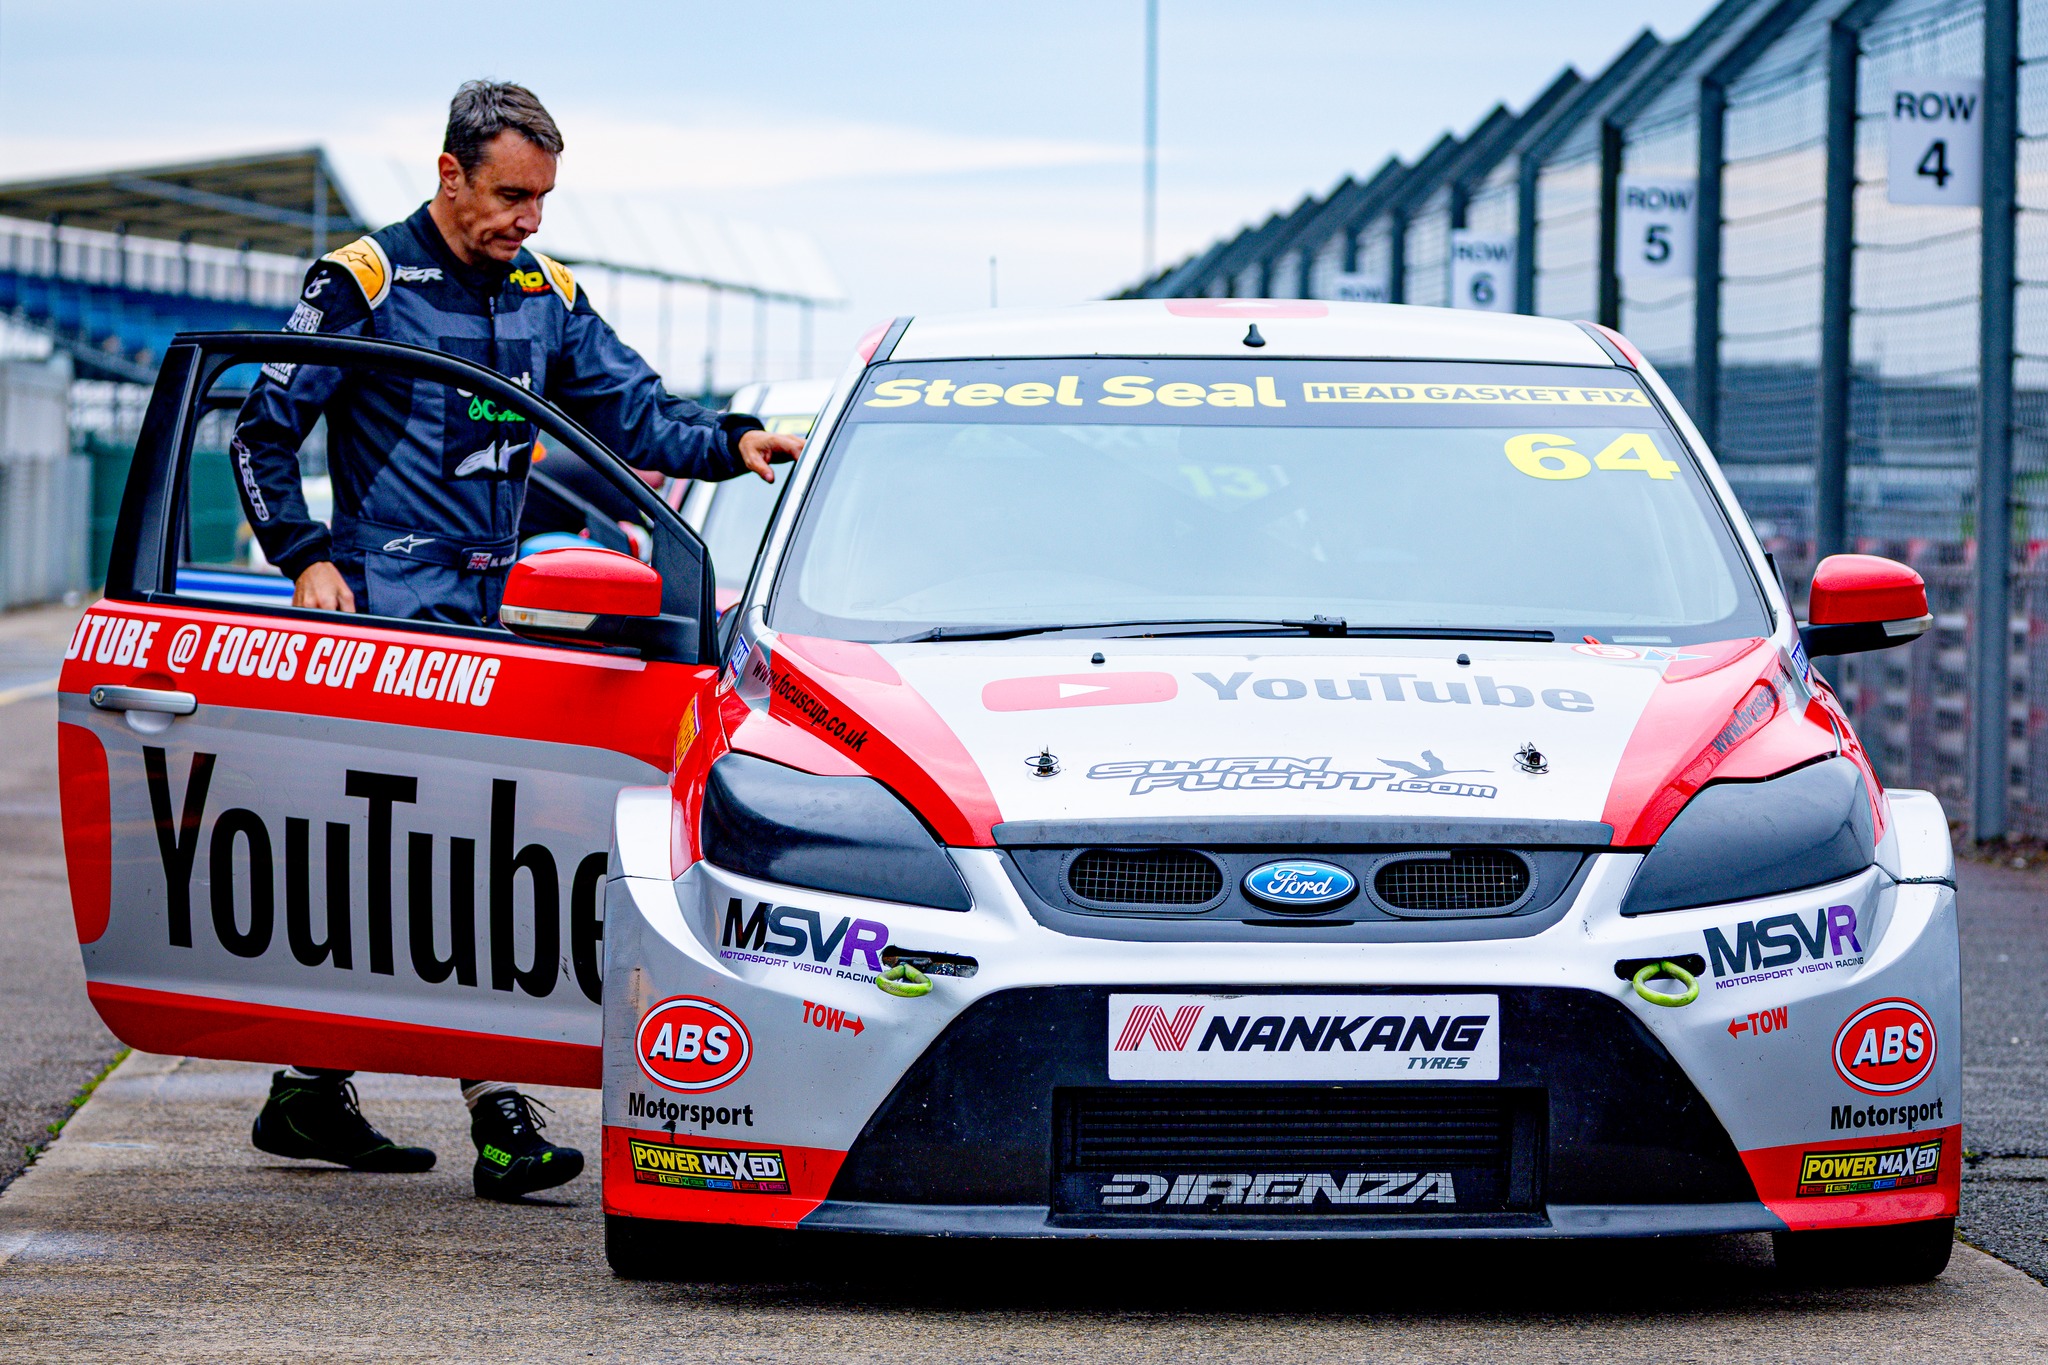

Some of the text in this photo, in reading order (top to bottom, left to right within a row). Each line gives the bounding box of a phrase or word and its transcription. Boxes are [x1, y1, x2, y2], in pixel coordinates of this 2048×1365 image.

[1894, 91, 1976, 120] ROW
[1917, 140, 1952, 187] 4
[1626, 186, 1690, 211] ROW
[1454, 241, 1510, 262] ROW
[1645, 225, 1671, 263] 5
[1470, 271, 1494, 305] 6
[863, 375, 1287, 408] Steel Seal
[1311, 386, 1646, 404] HEAD GASKET FIX
[1504, 433, 1681, 480] 64
[1178, 465, 1270, 497] 13
[167, 623, 201, 673] @
[201, 625, 307, 682] FOCUS
[304, 637, 376, 689] CUP
[373, 645, 501, 707] RACING
[752, 660, 868, 753] www.focuscup.co.uk
[1192, 672, 1595, 713] YouTube
[1086, 757, 1332, 779] SWAN
[142, 745, 608, 1006] YouTube
[1267, 868, 1333, 896] Ford
[722, 897, 890, 973] MSVR
[1703, 904, 1862, 978] MSVR
[719, 950, 789, 968] MOTORSPORT
[792, 961, 833, 976] VISION
[1715, 957, 1865, 990] MOTORSPORT VISION RACING
[802, 1000, 846, 1033] TOW
[1747, 1005, 1788, 1036] TOW
[648, 1022, 731, 1065] ABS
[1197, 1015, 1491, 1052] NANKANG
[1850, 1022, 1925, 1069] ABS
[1407, 1056, 1471, 1070] TYRES
[628, 1092, 753, 1130] Motorsport
[1831, 1097, 1943, 1130] Motorsport
[635, 1146, 703, 1173] POWER
[1806, 1156, 1878, 1180] POWER
[1100, 1172, 1457, 1205] DIRENZA
